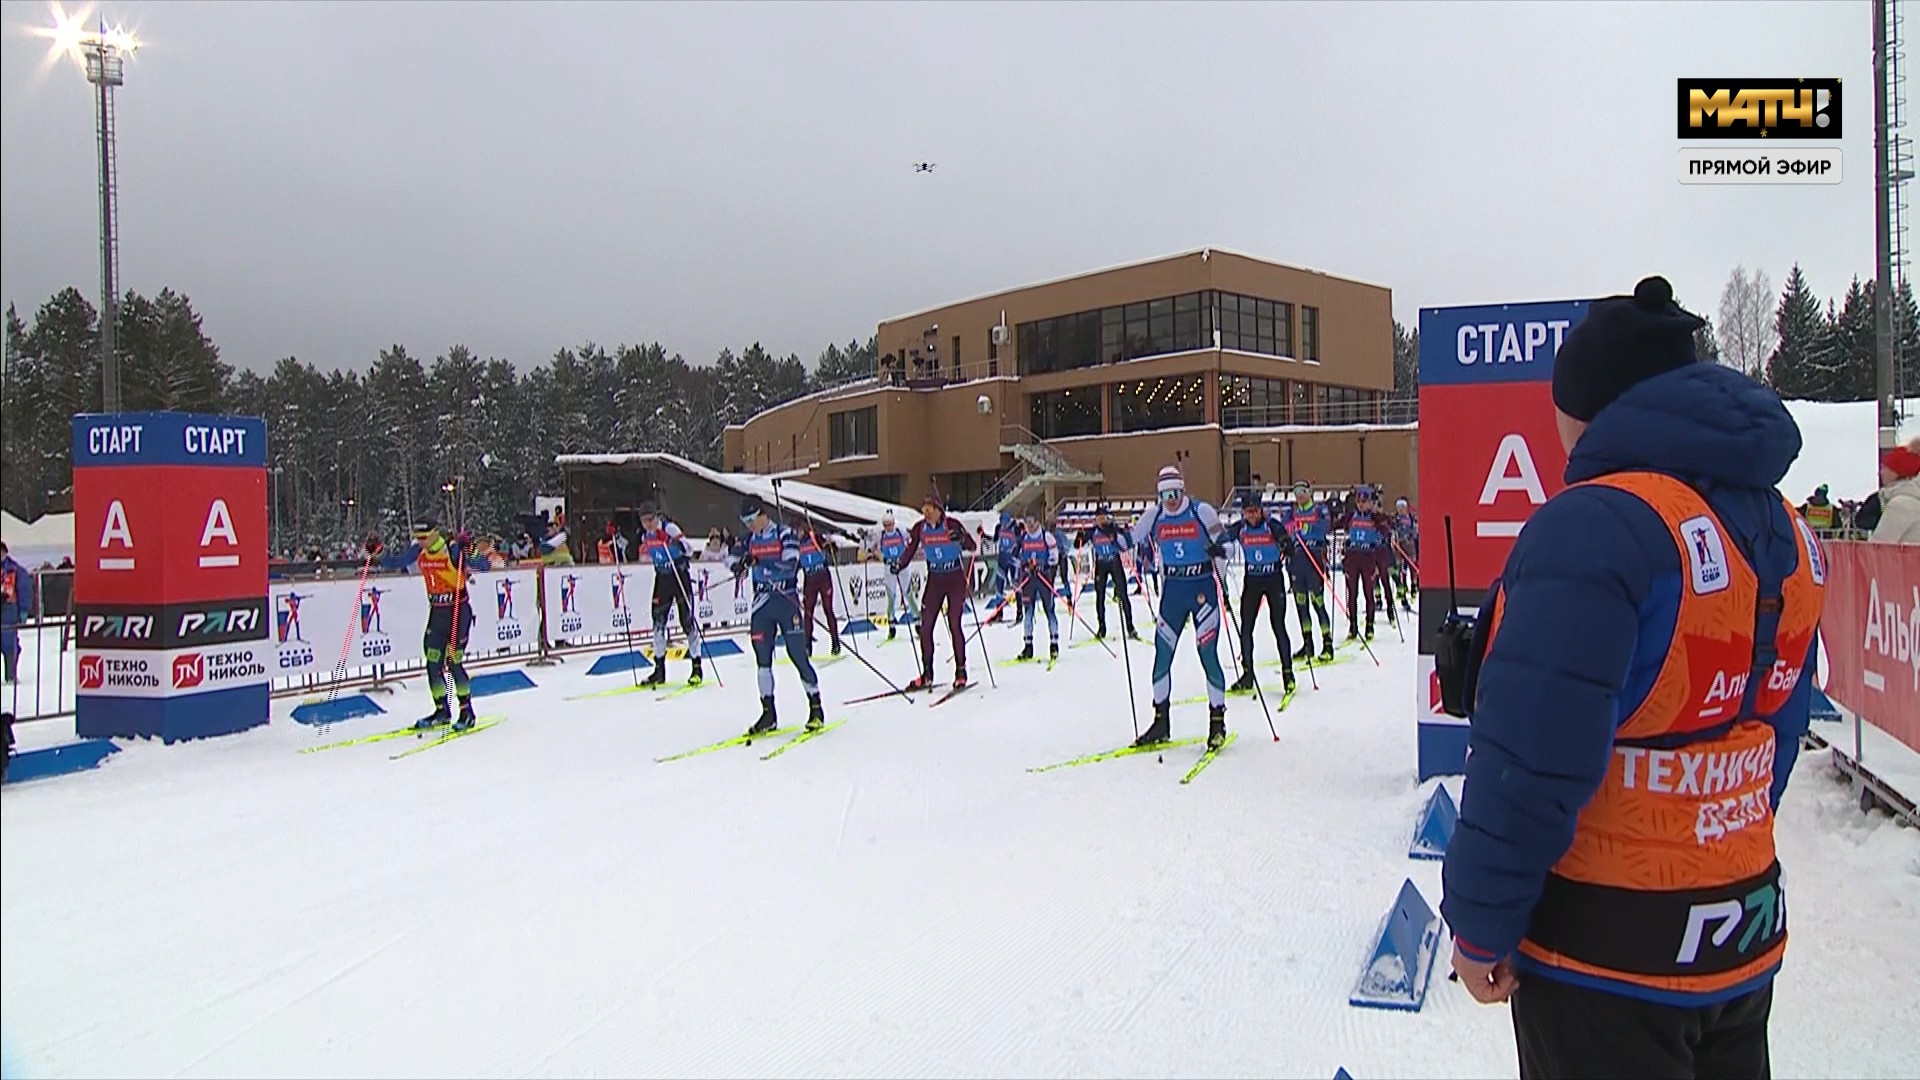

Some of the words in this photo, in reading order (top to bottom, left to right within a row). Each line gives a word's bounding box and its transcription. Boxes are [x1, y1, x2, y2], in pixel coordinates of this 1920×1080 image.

[1457, 319, 1570, 365] СТАРТ
[89, 425, 143, 455] СТАРТ
[185, 425, 246, 455] СТАРТ
[934, 547, 943, 559] 5
[1173, 541, 1185, 559] 3
[1254, 550, 1263, 562] 6
[83, 615, 154, 638] PARI
[178, 607, 260, 638] PARI
[561, 622, 582, 633] СБР
[497, 629, 522, 641] СБР
[206, 651, 253, 667] ТЕХНО
[362, 645, 392, 658] СБР
[106, 659, 148, 673] ТЕХНО
[279, 654, 314, 668] СБР
[107, 674, 160, 687] НИКОЛЬ
[208, 663, 265, 681] НИКОЛЬ
[1615, 735, 1776, 796] ТЕХНИЧЕ
[1676, 882, 1785, 963] PA
